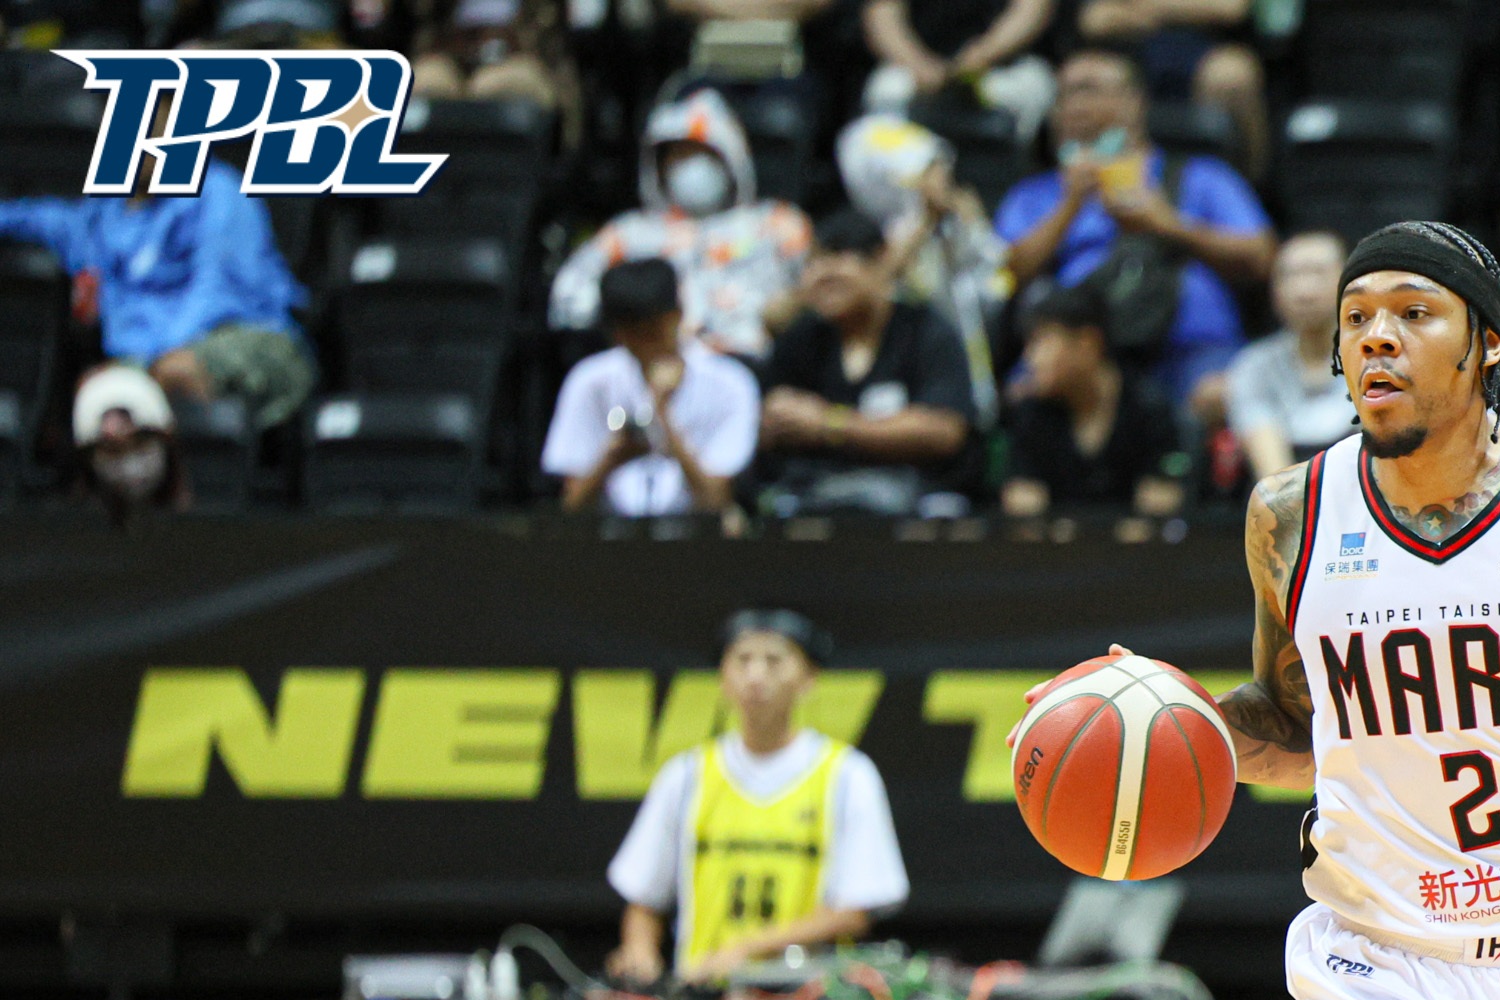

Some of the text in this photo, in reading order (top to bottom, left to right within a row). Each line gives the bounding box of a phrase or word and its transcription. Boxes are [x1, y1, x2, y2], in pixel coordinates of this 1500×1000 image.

[1324, 559, 1379, 576] 保瑞集團
[1346, 607, 1422, 626] TAIPEI
[120, 667, 886, 800] NEW
[1114, 820, 1132, 856] BG4550
[1424, 912, 1458, 924] SHIN
